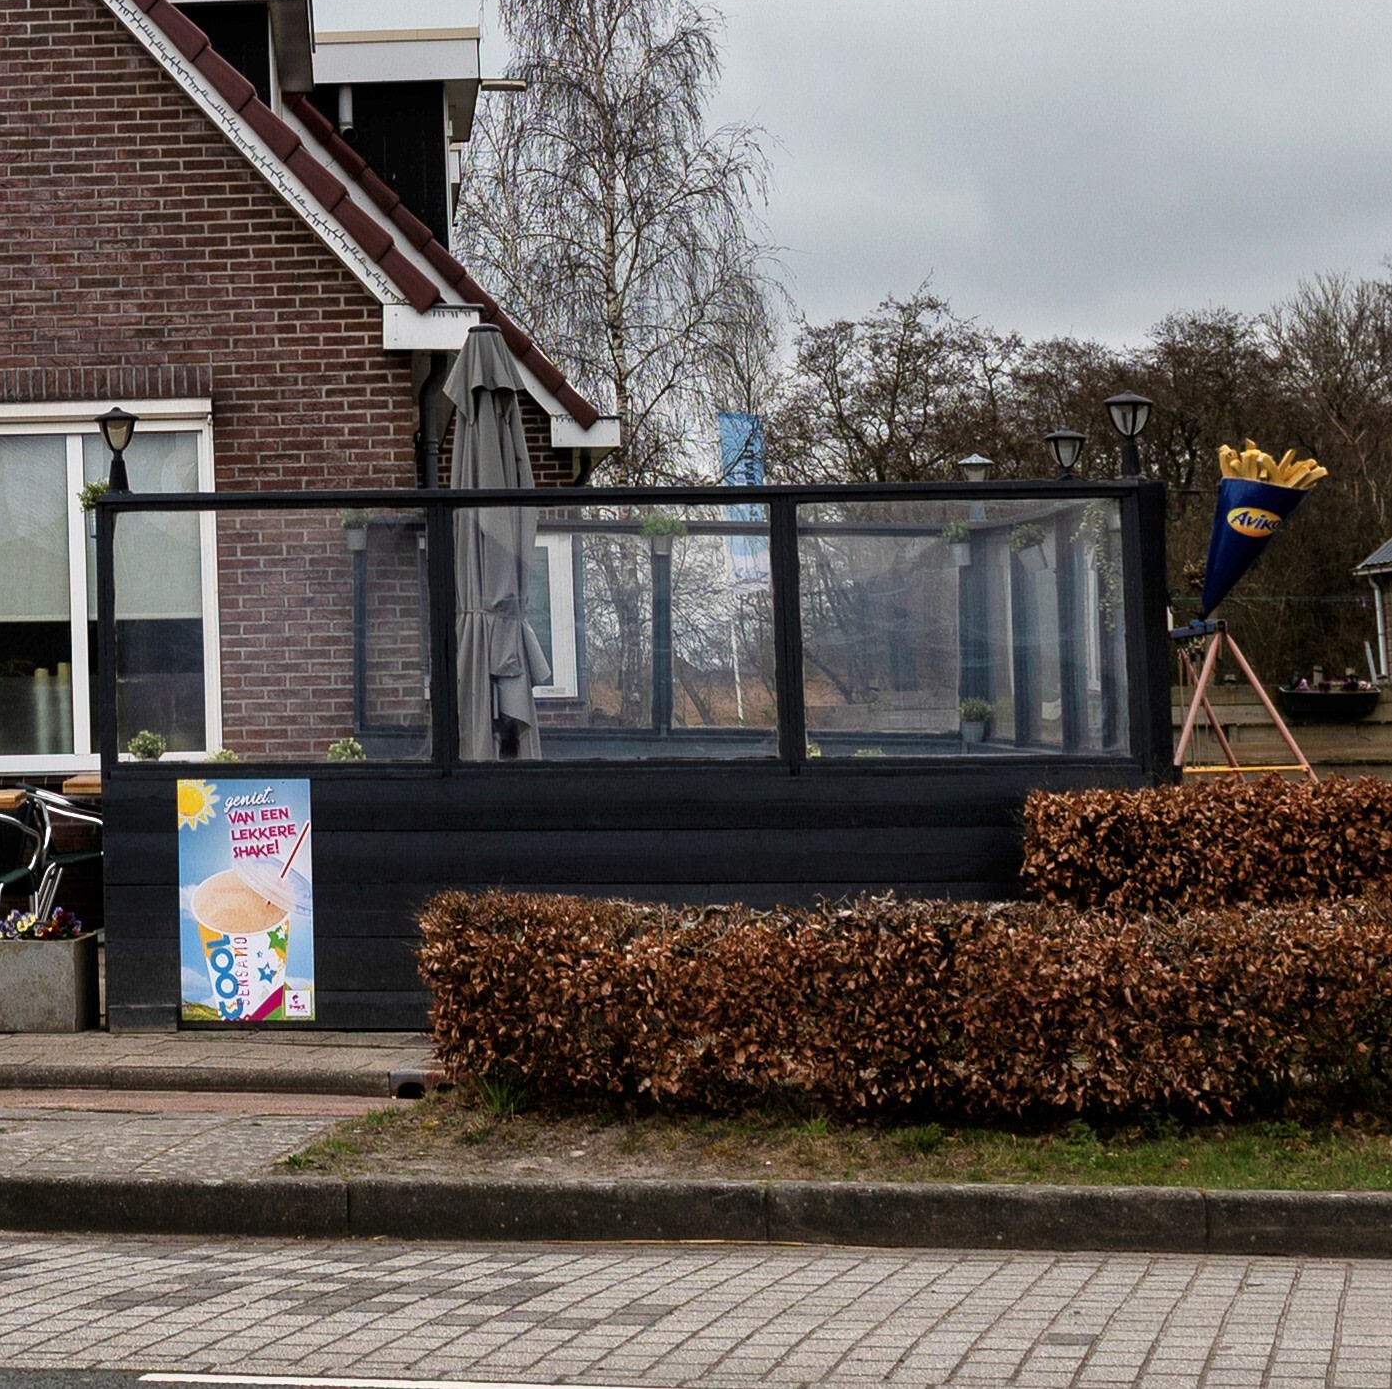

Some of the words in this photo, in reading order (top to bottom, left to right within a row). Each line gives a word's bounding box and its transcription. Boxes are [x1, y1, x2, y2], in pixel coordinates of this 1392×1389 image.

[1230, 510, 1281, 530] Aviko
[228, 810, 255, 825] VAN
[261, 807, 289, 821] EEN
[231, 824, 297, 841] LEKKERE
[233, 839, 280, 859] SHAKE!
[206, 933, 244, 1020] COOL
